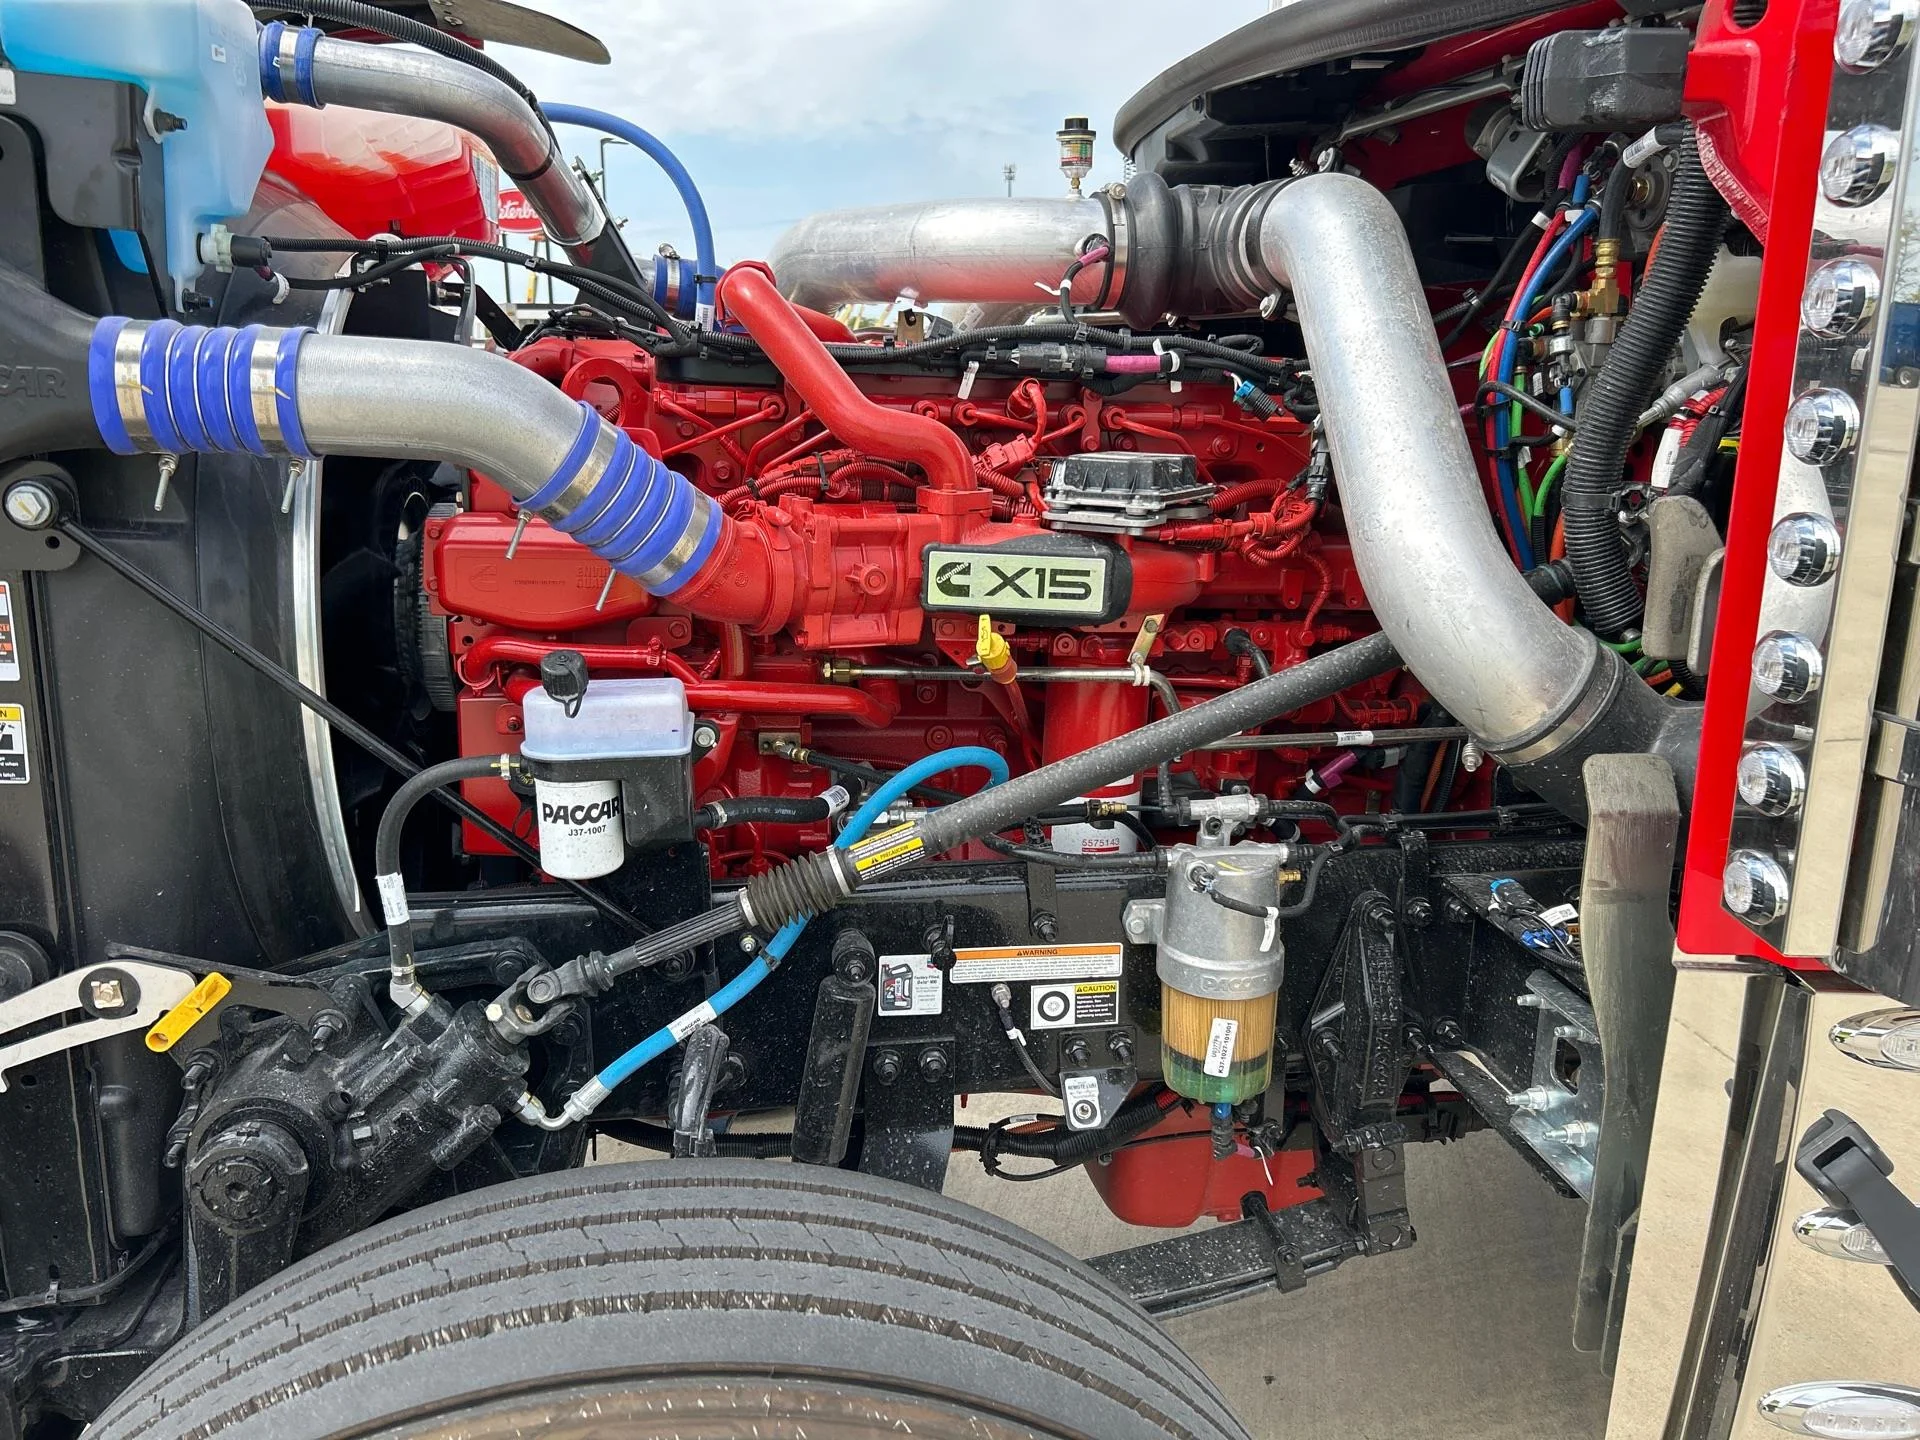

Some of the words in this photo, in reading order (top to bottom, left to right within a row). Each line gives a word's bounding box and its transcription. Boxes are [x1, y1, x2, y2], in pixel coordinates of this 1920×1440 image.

[936, 561, 970, 584] Cummins
[984, 565, 1092, 600] X15
[542, 795, 620, 825] PACCAR
[568, 824, 607, 836] J37-1007
[1082, 837, 1120, 847] 5575143
[1022, 948, 1058, 956] WARNING
[1083, 984, 1116, 992] CAUTION
[1218, 1022, 1233, 1074] K37-1027-101001
